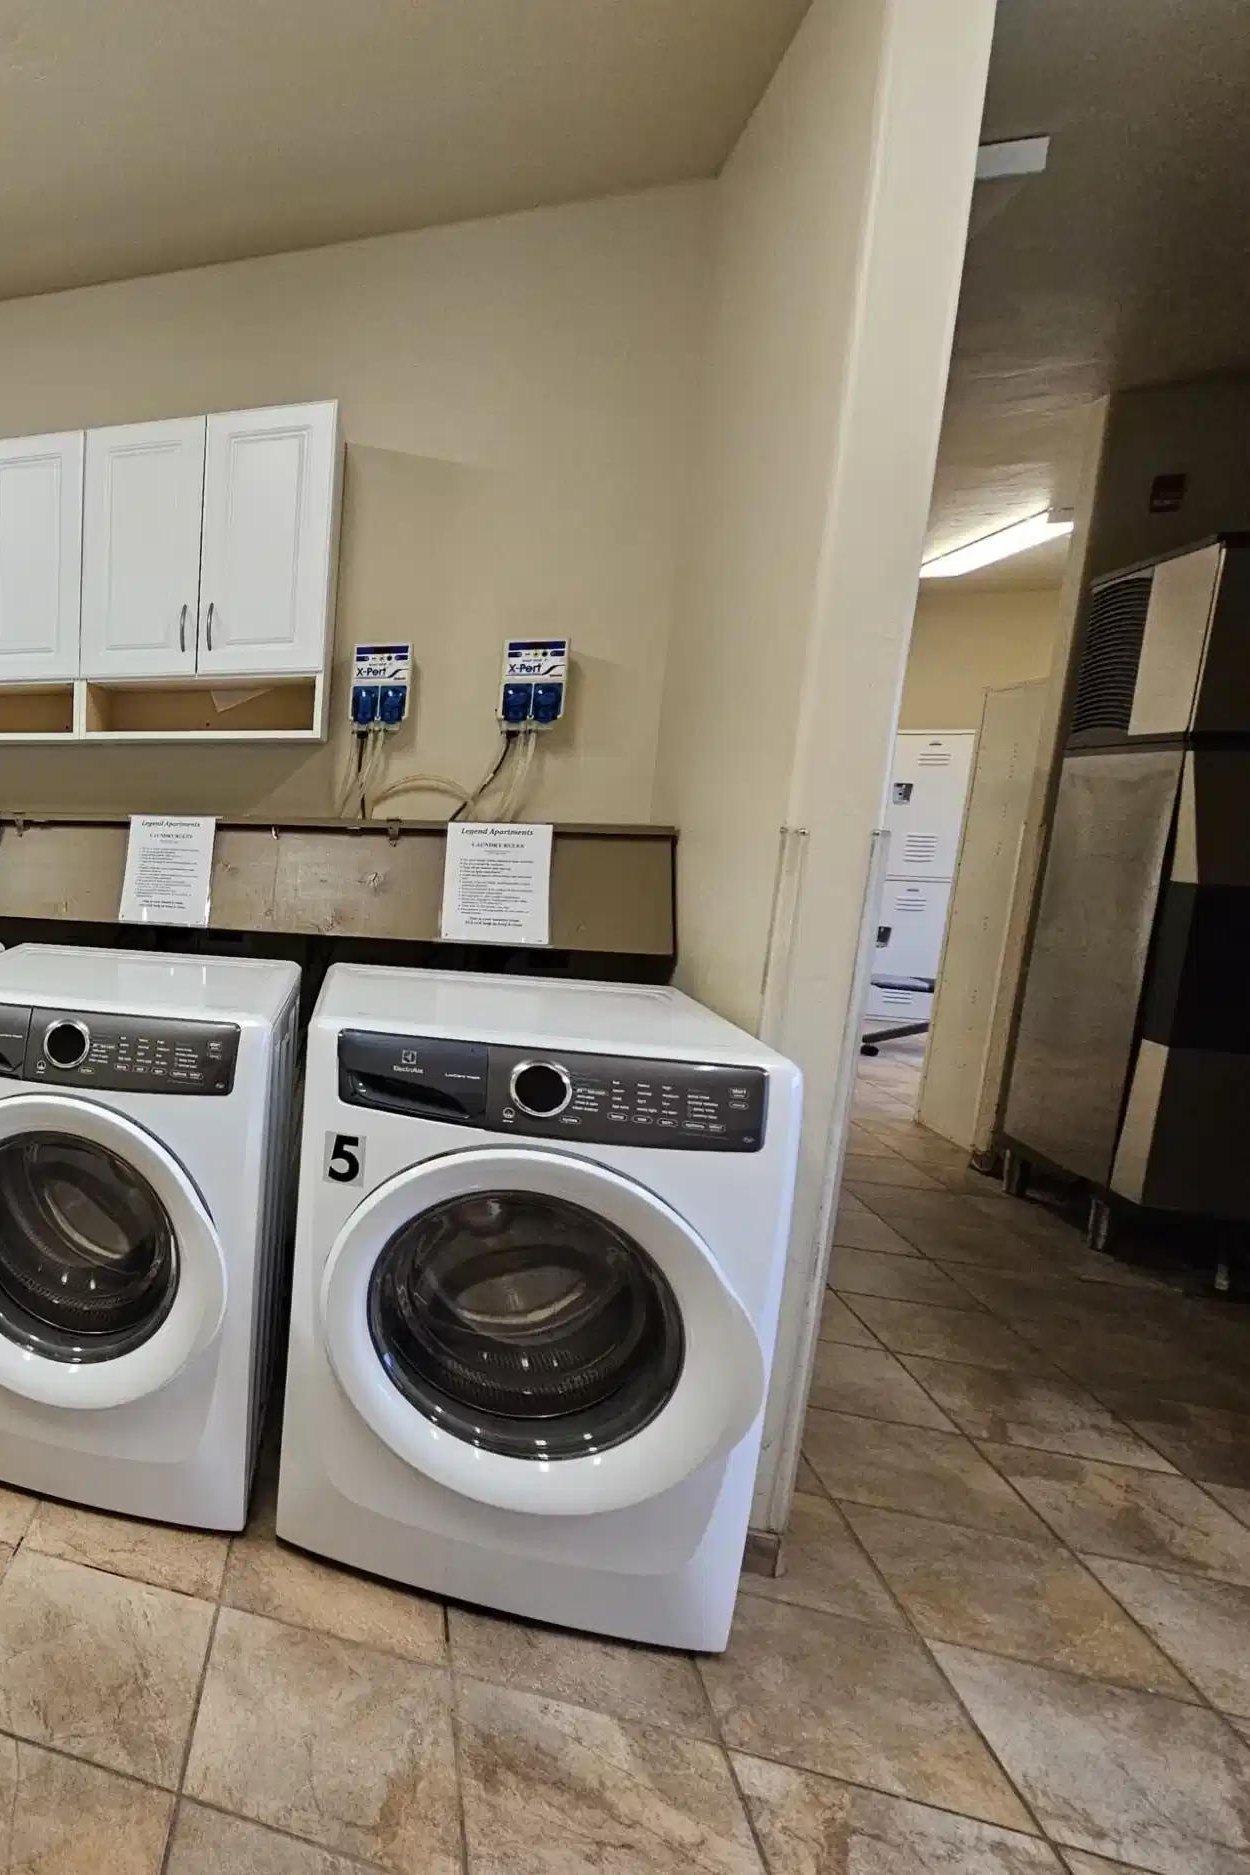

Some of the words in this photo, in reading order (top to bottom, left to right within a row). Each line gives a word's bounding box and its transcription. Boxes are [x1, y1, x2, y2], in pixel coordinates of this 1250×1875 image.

[356, 667, 387, 677] X-Pert
[508, 663, 542, 673] X-Pert
[461, 827, 488, 836] Legend
[488, 828, 534, 837] Apartments
[328, 1134, 360, 1183] 5
